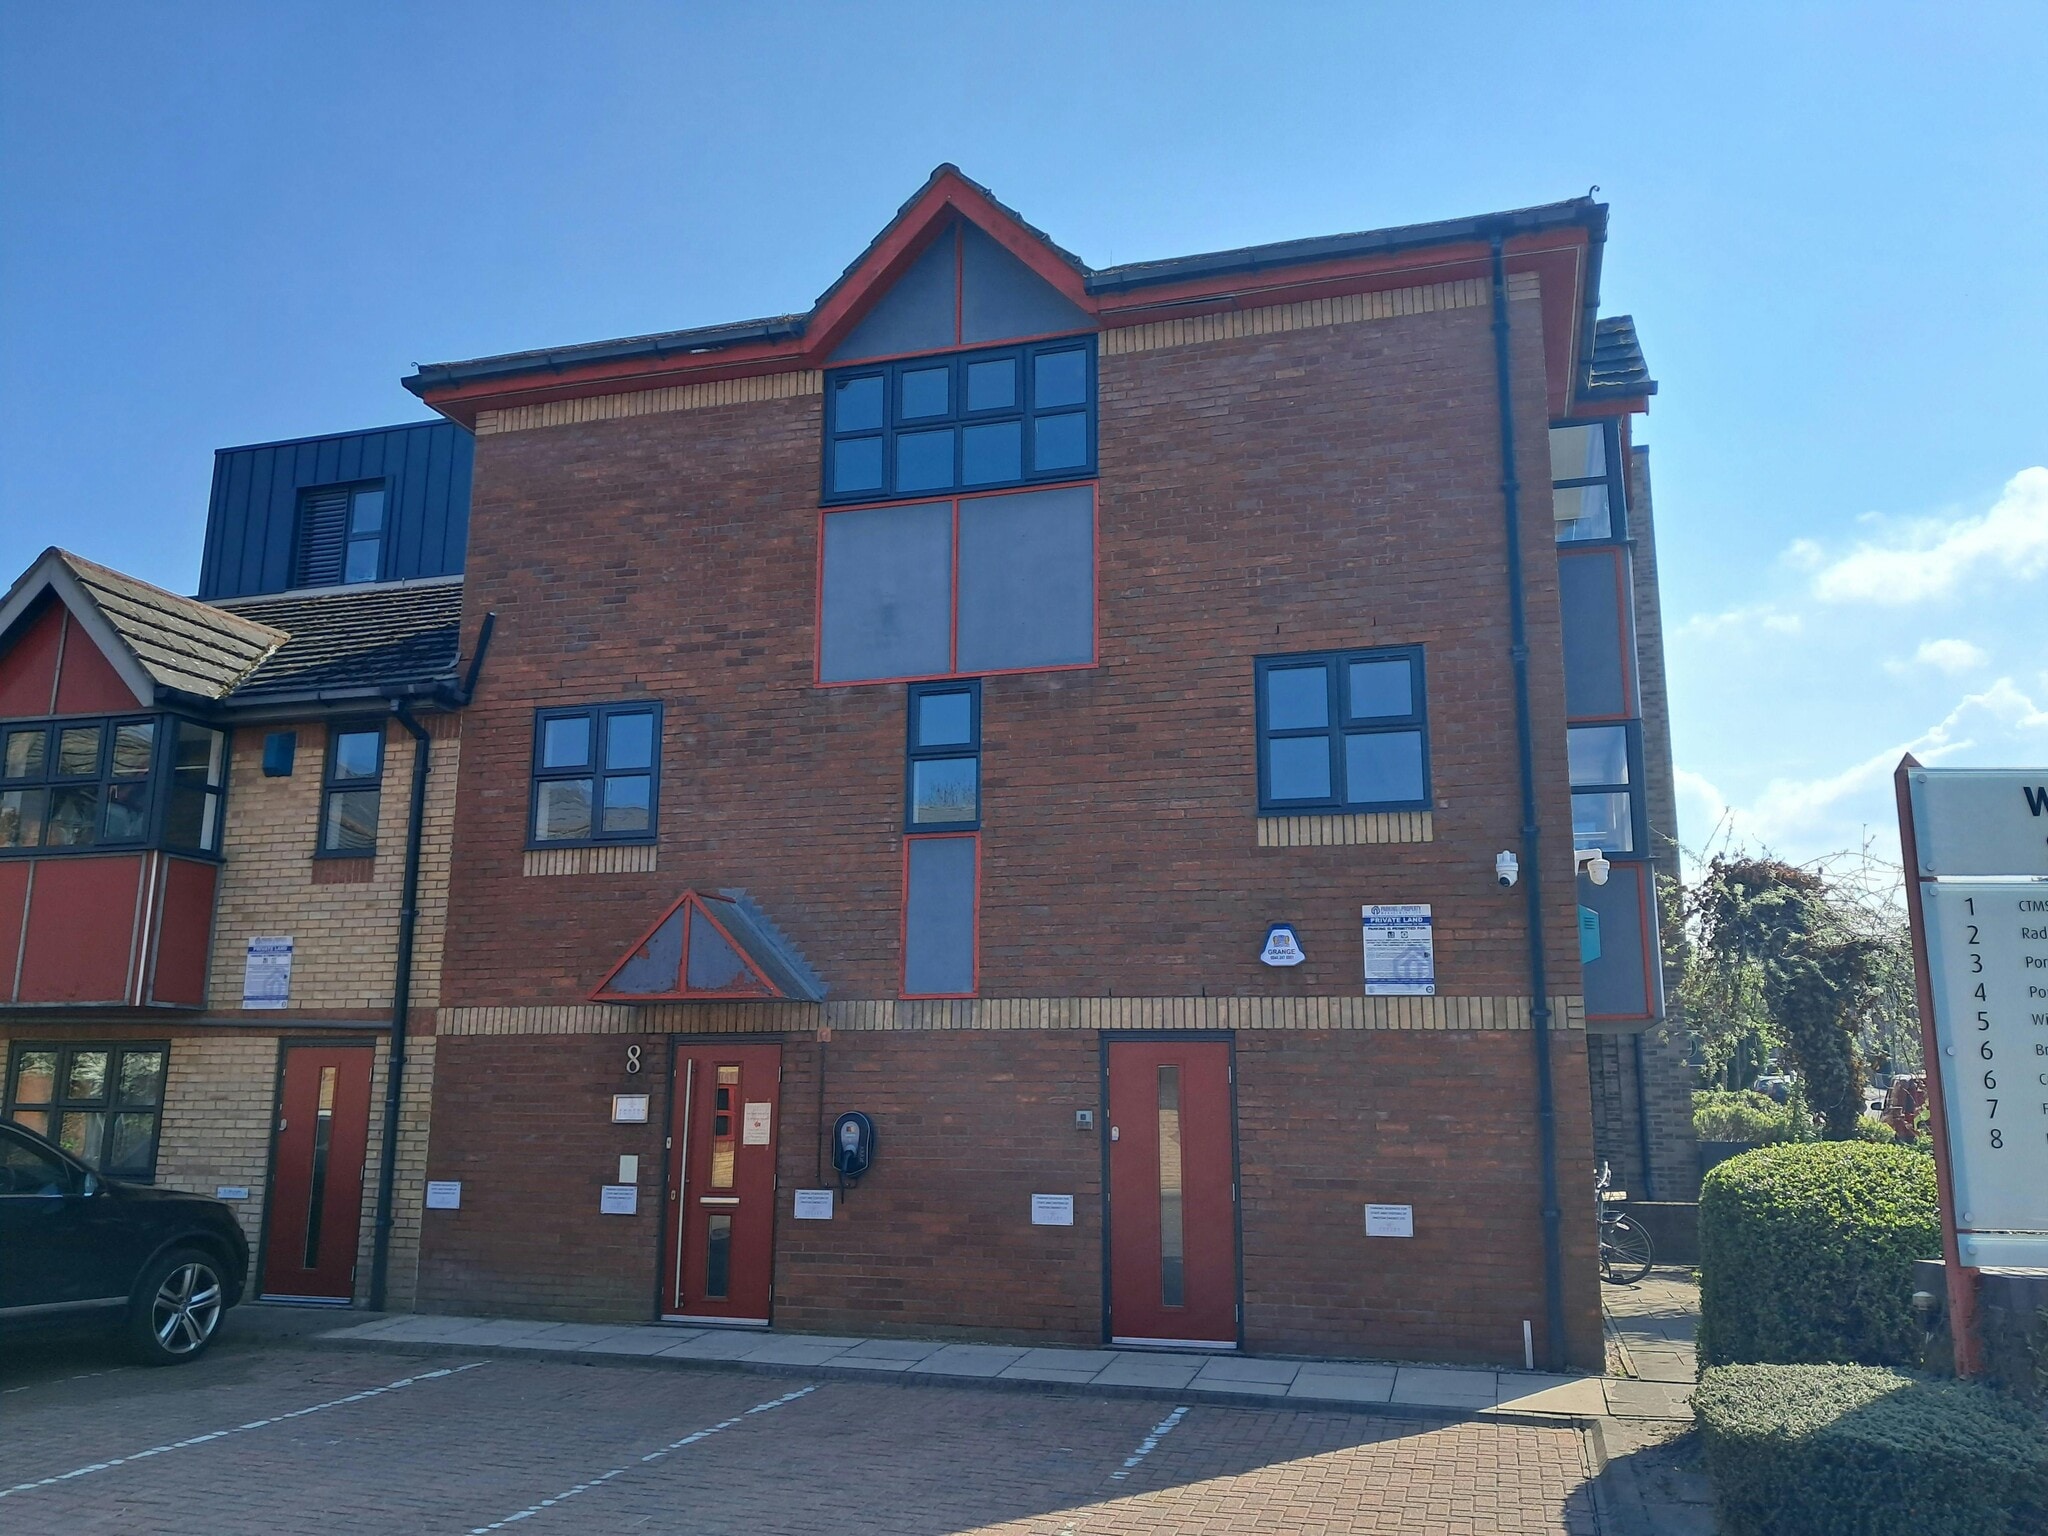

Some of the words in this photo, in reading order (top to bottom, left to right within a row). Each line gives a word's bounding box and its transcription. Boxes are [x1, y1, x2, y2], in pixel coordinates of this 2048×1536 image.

[1965, 897, 1974, 916] 1
[1967, 925, 1980, 945] 2
[1267, 948, 1296, 956] GRANGE
[1970, 953, 1983, 973] 3
[1974, 982, 1986, 1002] 4
[2029, 985, 2048, 999] Po
[1977, 1011, 1990, 1031] 5
[626, 1044, 641, 1074] 8
[1980, 1040, 1993, 1060] 6
[1984, 1070, 1997, 1090] 6
[1986, 1099, 1999, 1119] 7
[1990, 1128, 2004, 1149] 8
